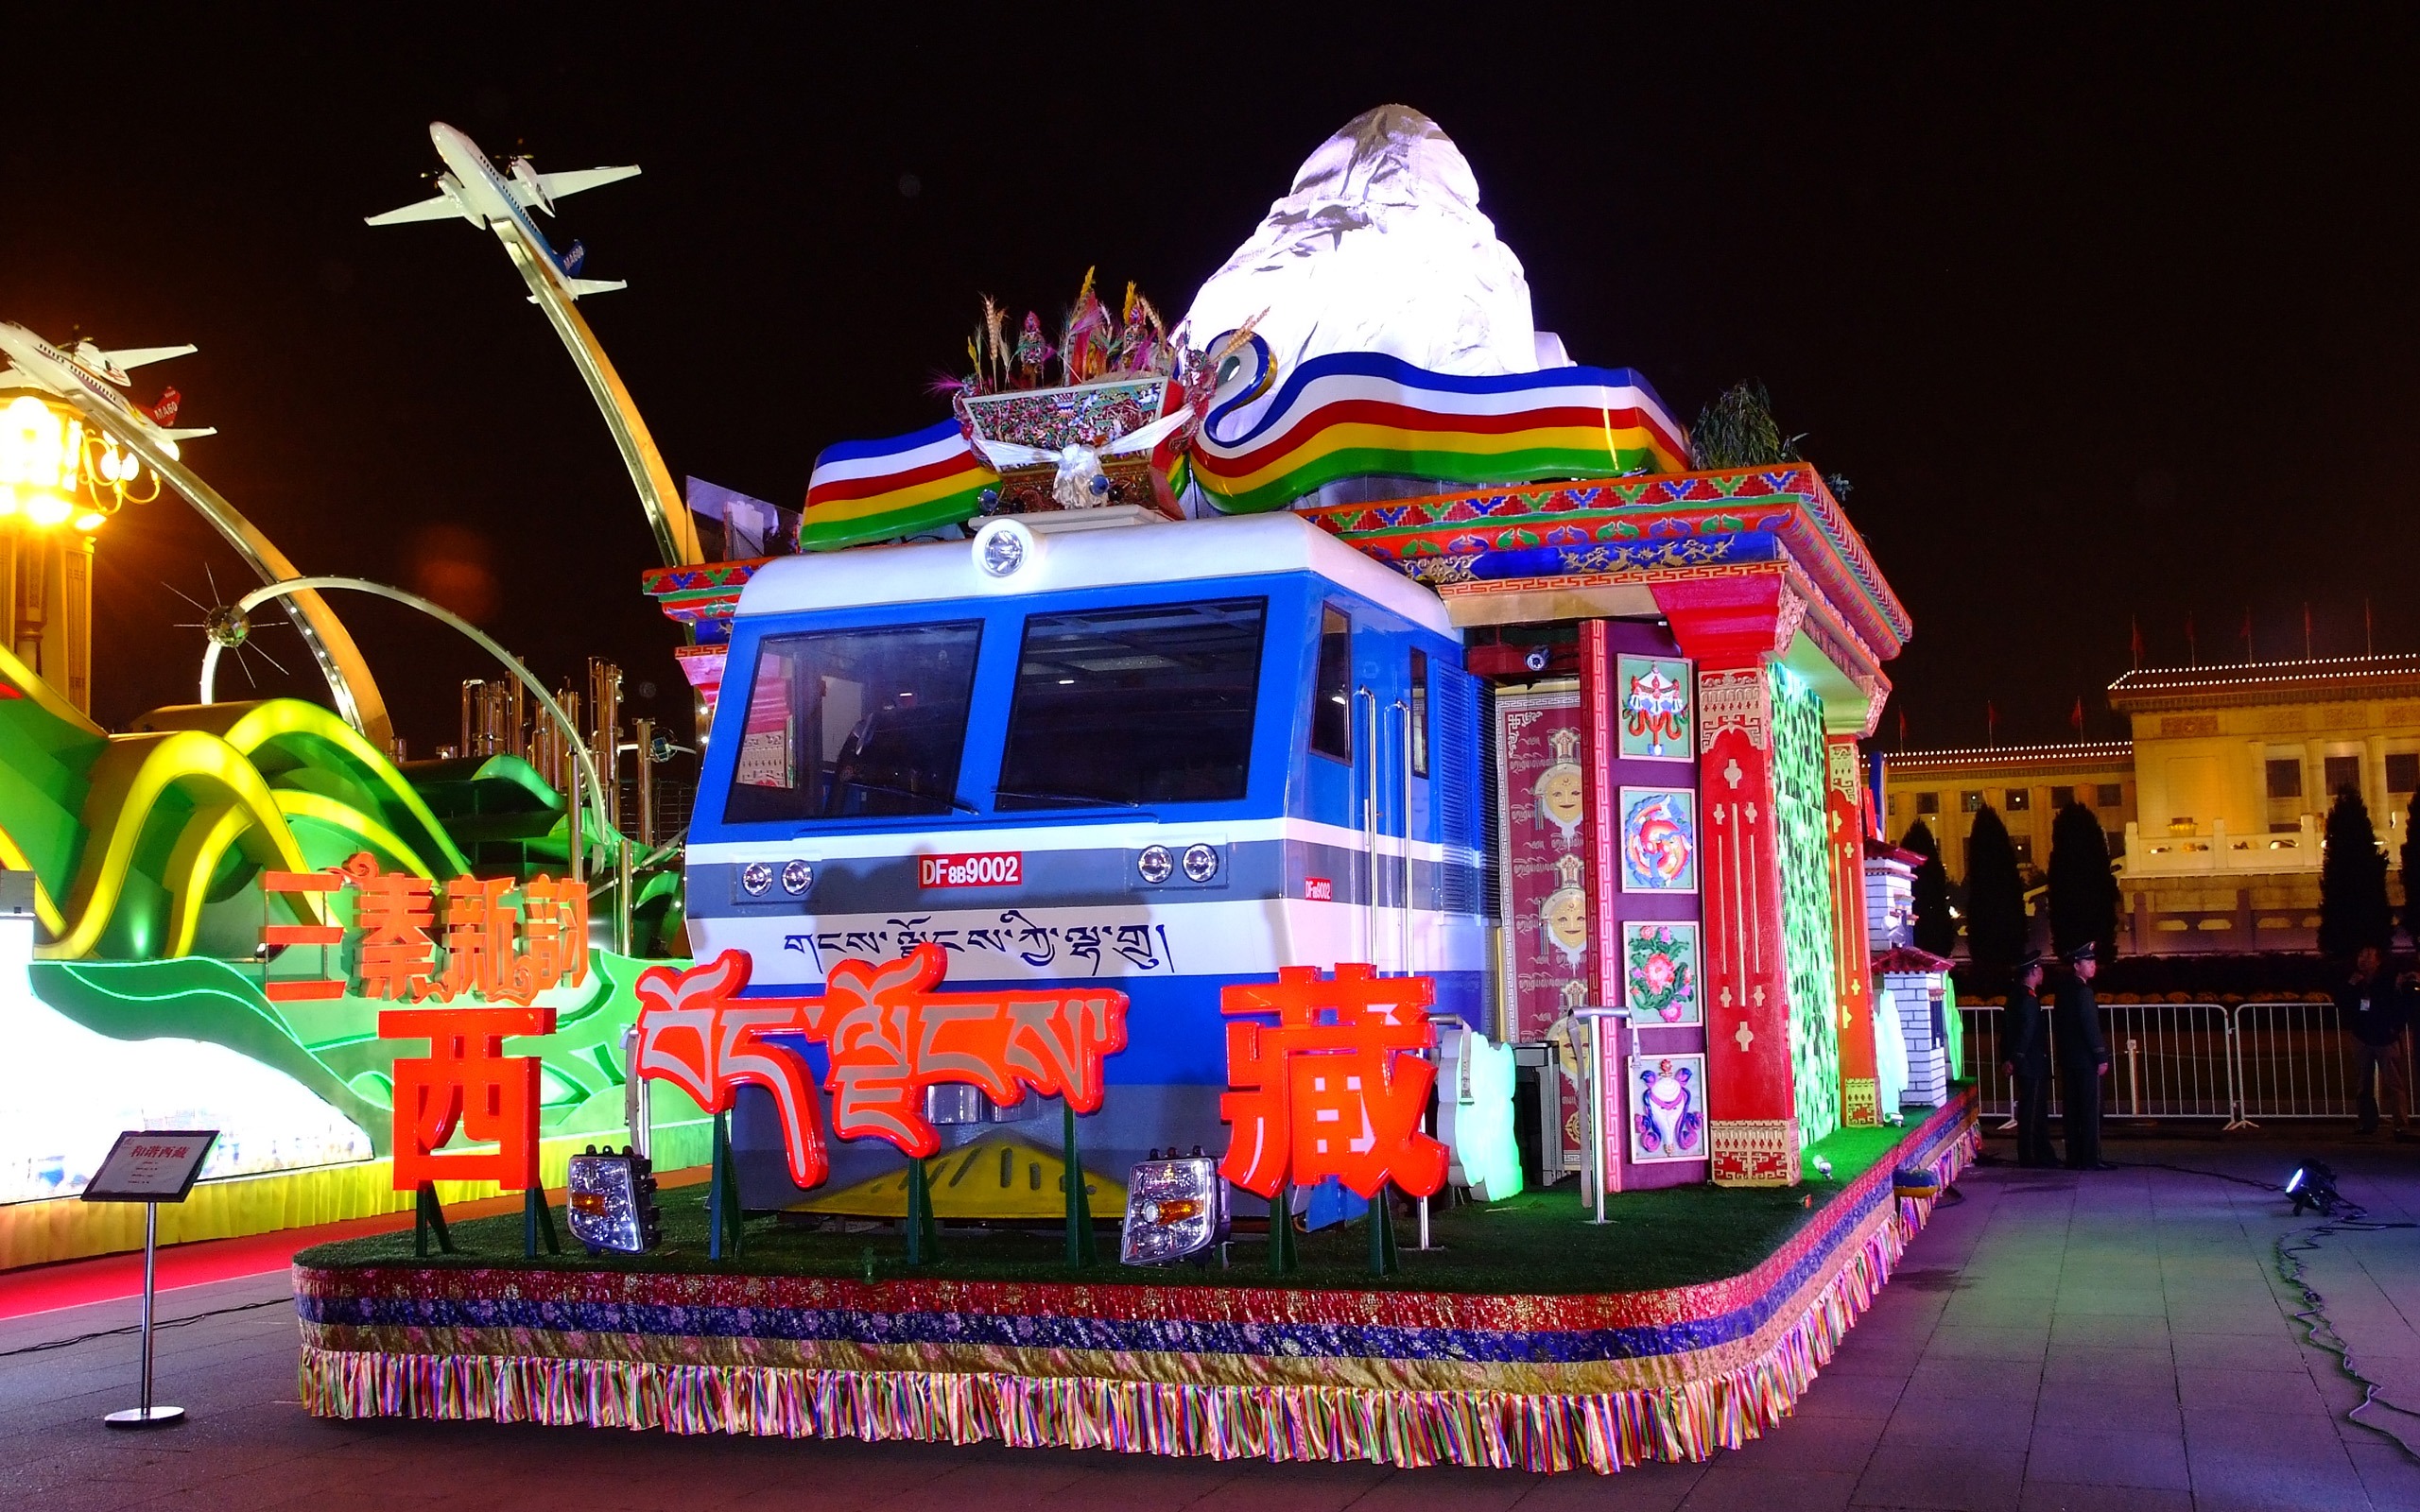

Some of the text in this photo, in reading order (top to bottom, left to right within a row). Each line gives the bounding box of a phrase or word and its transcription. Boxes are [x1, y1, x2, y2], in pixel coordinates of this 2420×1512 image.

[153, 401, 179, 420] MA60
[923, 855, 1019, 885] DF8B9002
[259, 869, 590, 1005] 三秦新韵
[379, 1007, 557, 1191] 西
[1218, 962, 1450, 1199] 藏
[130, 1144, 190, 1159] 和谐西藏
